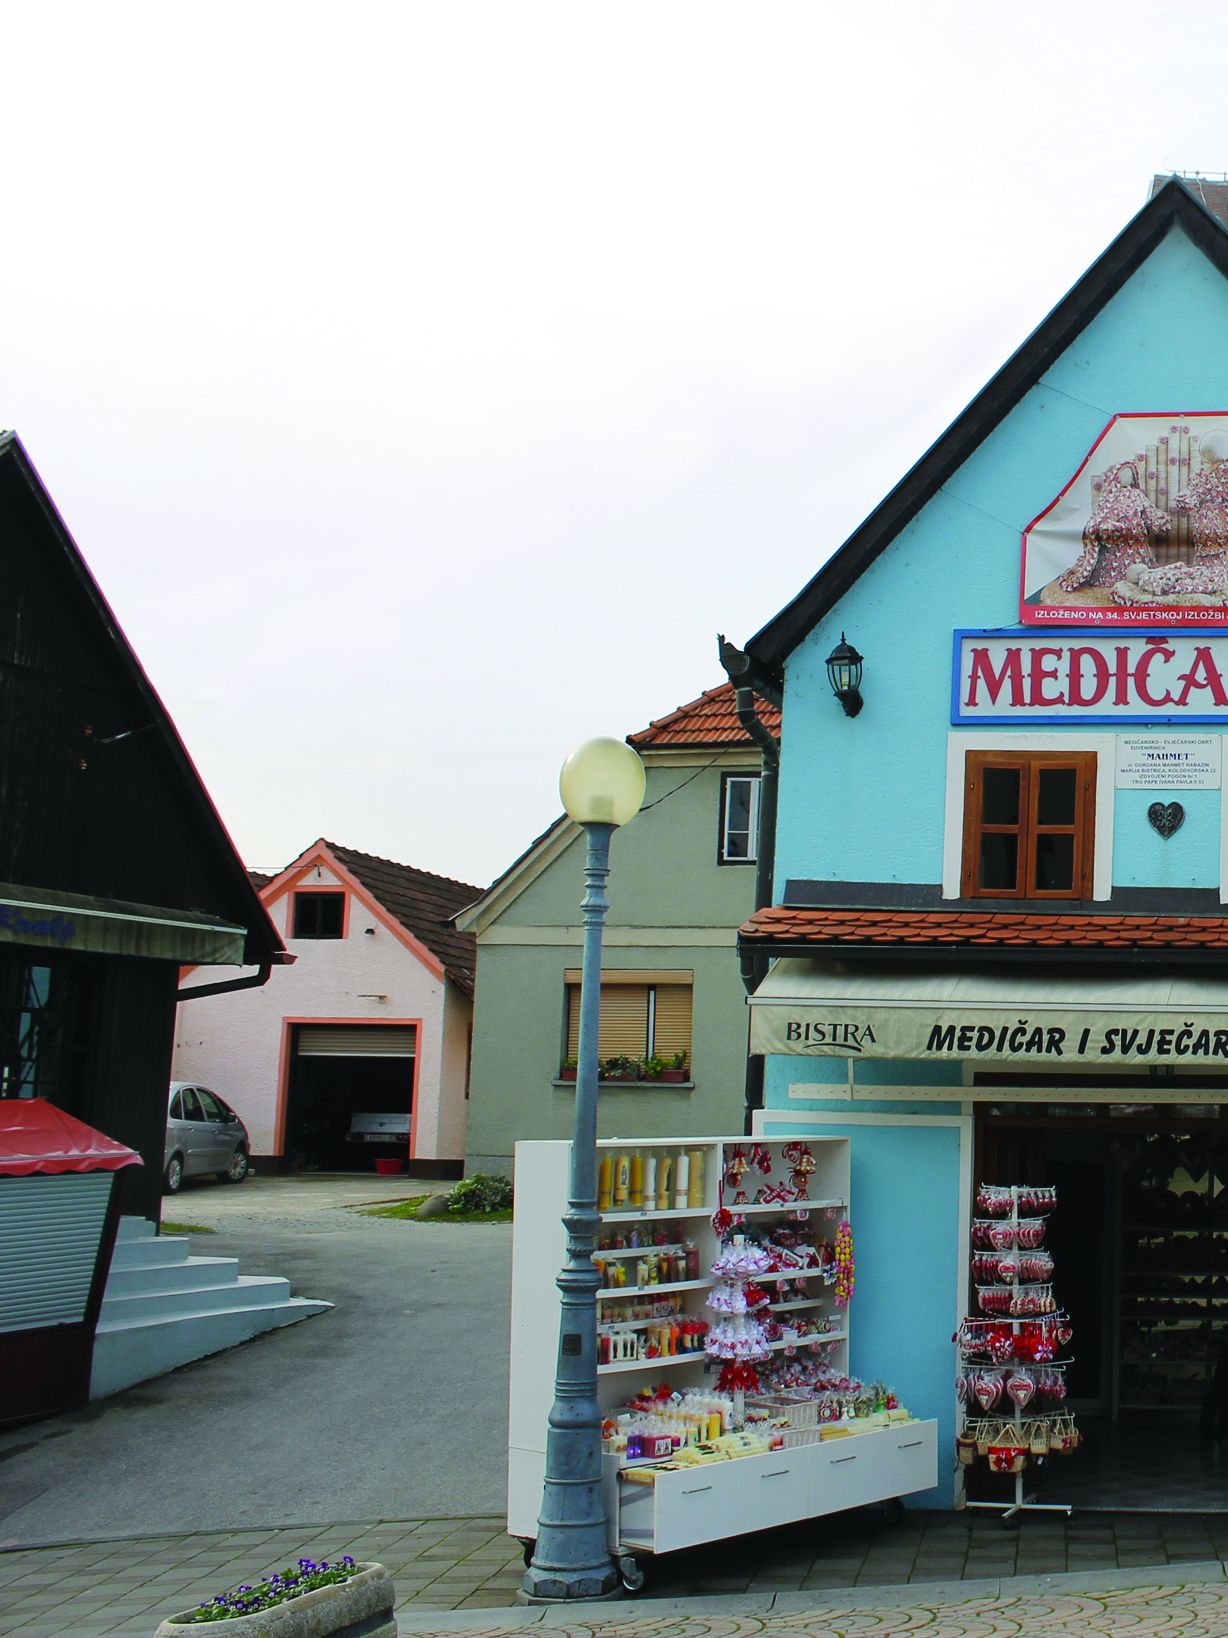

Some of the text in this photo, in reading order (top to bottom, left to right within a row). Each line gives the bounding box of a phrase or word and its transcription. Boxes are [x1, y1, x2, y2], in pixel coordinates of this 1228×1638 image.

[1034, 608, 1086, 619] IZLOŽENO
[1088, 611, 1104, 619] NA
[1106, 611, 1121, 620] 34.
[1123, 611, 1182, 620] SVJETSKOJ
[1185, 609, 1225, 620] IZLOŽBI
[786, 1021, 877, 1048] BISTRA
[926, 1019, 1066, 1056] MEDIČAR
[1077, 1027, 1091, 1055] I
